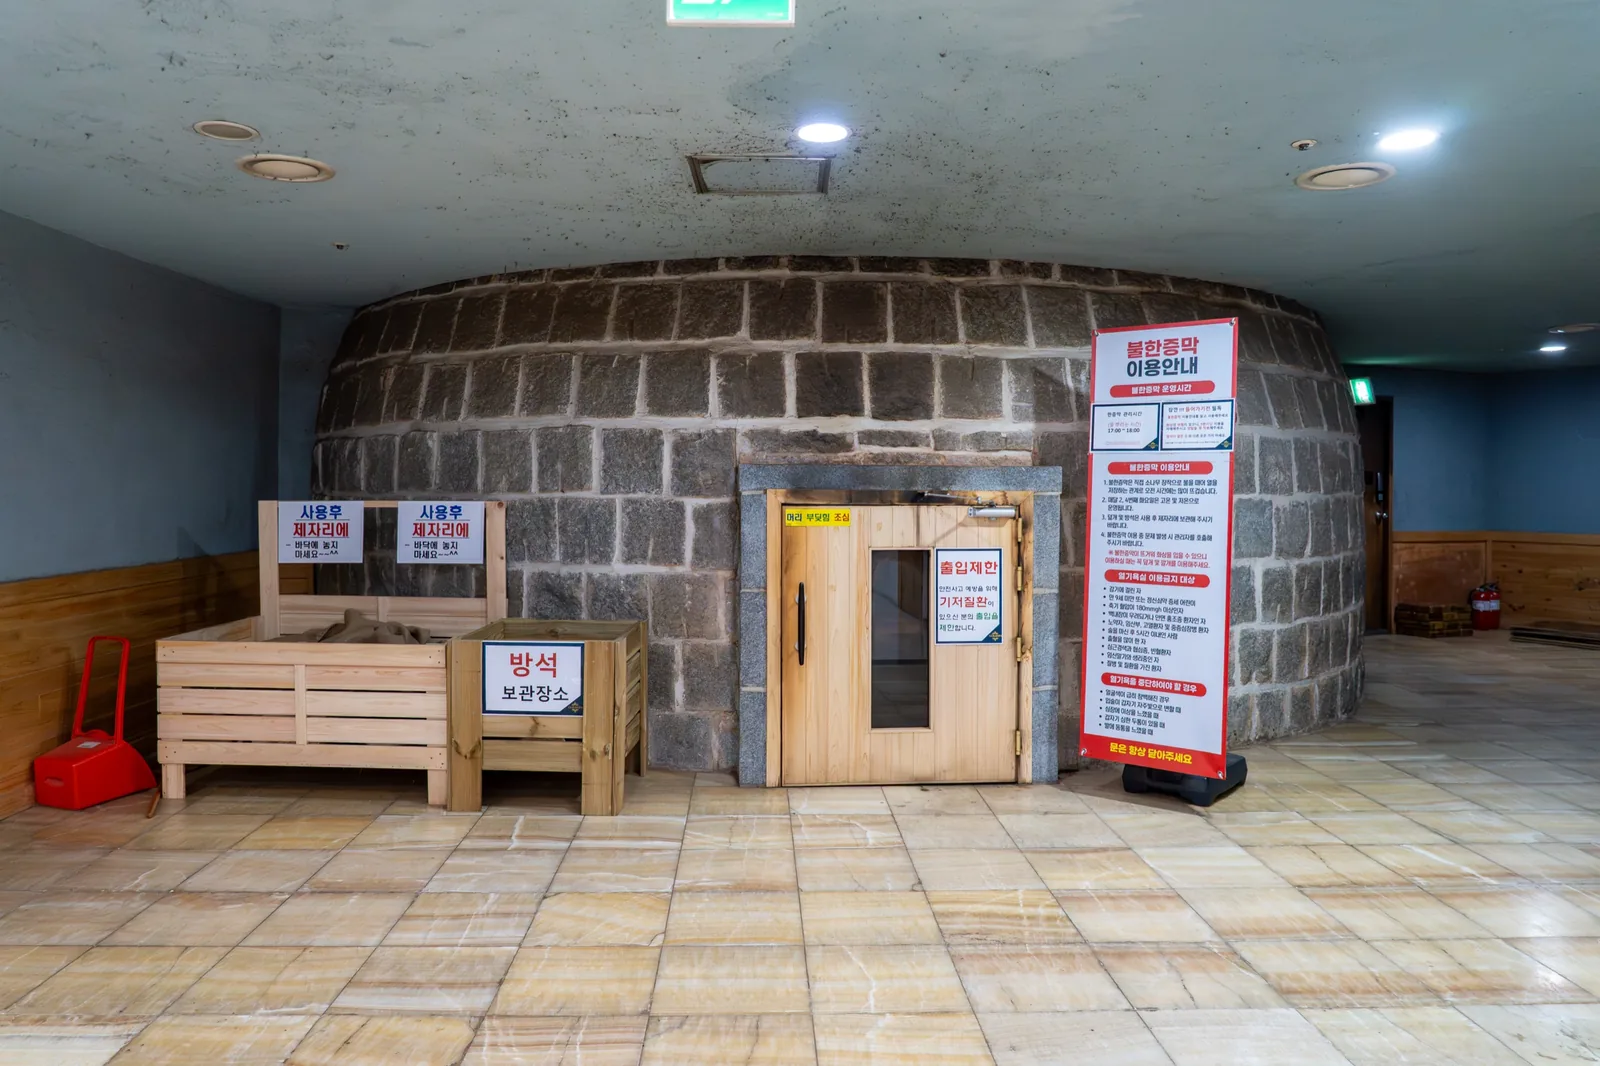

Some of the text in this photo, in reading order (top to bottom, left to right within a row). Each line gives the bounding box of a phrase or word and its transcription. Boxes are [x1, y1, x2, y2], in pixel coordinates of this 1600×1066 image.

[1127, 337, 1199, 358] 불한증막
[1127, 357, 1198, 377] 이용안내
[1132, 384, 1191, 394] 불한증막 운영시간
[301, 505, 342, 519] 사용후
[420, 505, 462, 519] 사용후
[787, 513, 802, 521] 머리
[835, 513, 849, 521] 조심
[293, 523, 348, 537] 제자리에
[412, 523, 468, 537] 제자리에
[323, 541, 338, 549] 놓지
[443, 542, 458, 550] 놓지
[941, 561, 998, 574] 출입제한
[1118, 572, 1195, 584] 열기욕실 이용금지 대상
[940, 597, 994, 608] 기저질환이
[510, 652, 556, 678] 방석
[502, 685, 568, 702] 보관장소
[1183, 684, 1196, 692] 경우
[1110, 742, 1126, 753] 문은
[1129, 745, 1146, 756] 항상
